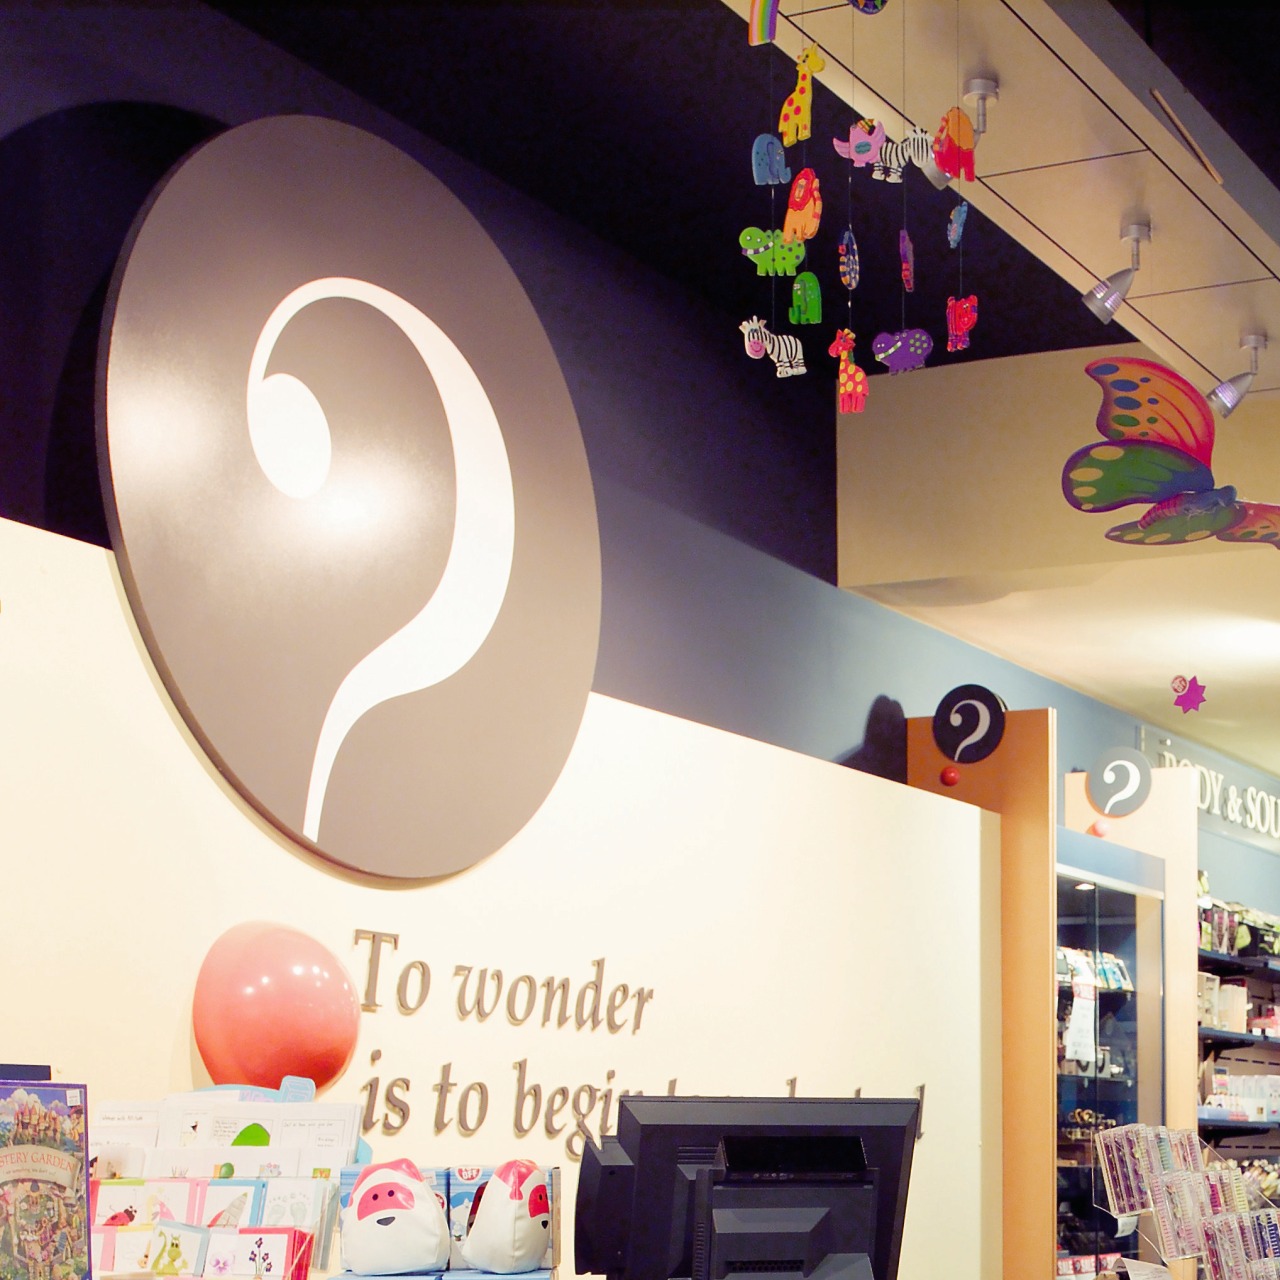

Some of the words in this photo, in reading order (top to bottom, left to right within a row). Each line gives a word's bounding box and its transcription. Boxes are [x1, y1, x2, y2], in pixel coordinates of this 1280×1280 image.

[1227, 785, 1242, 823] &
[354, 929, 431, 1015] To
[453, 957, 654, 1035] wonder
[360, 1048, 411, 1136] is
[433, 1062, 489, 1138] to
[512, 1058, 644, 1162] begi
[0, 1152, 29, 1168] STERY
[31, 1152, 73, 1173] GARDEN
[462, 1169, 480, 1180] OFF
